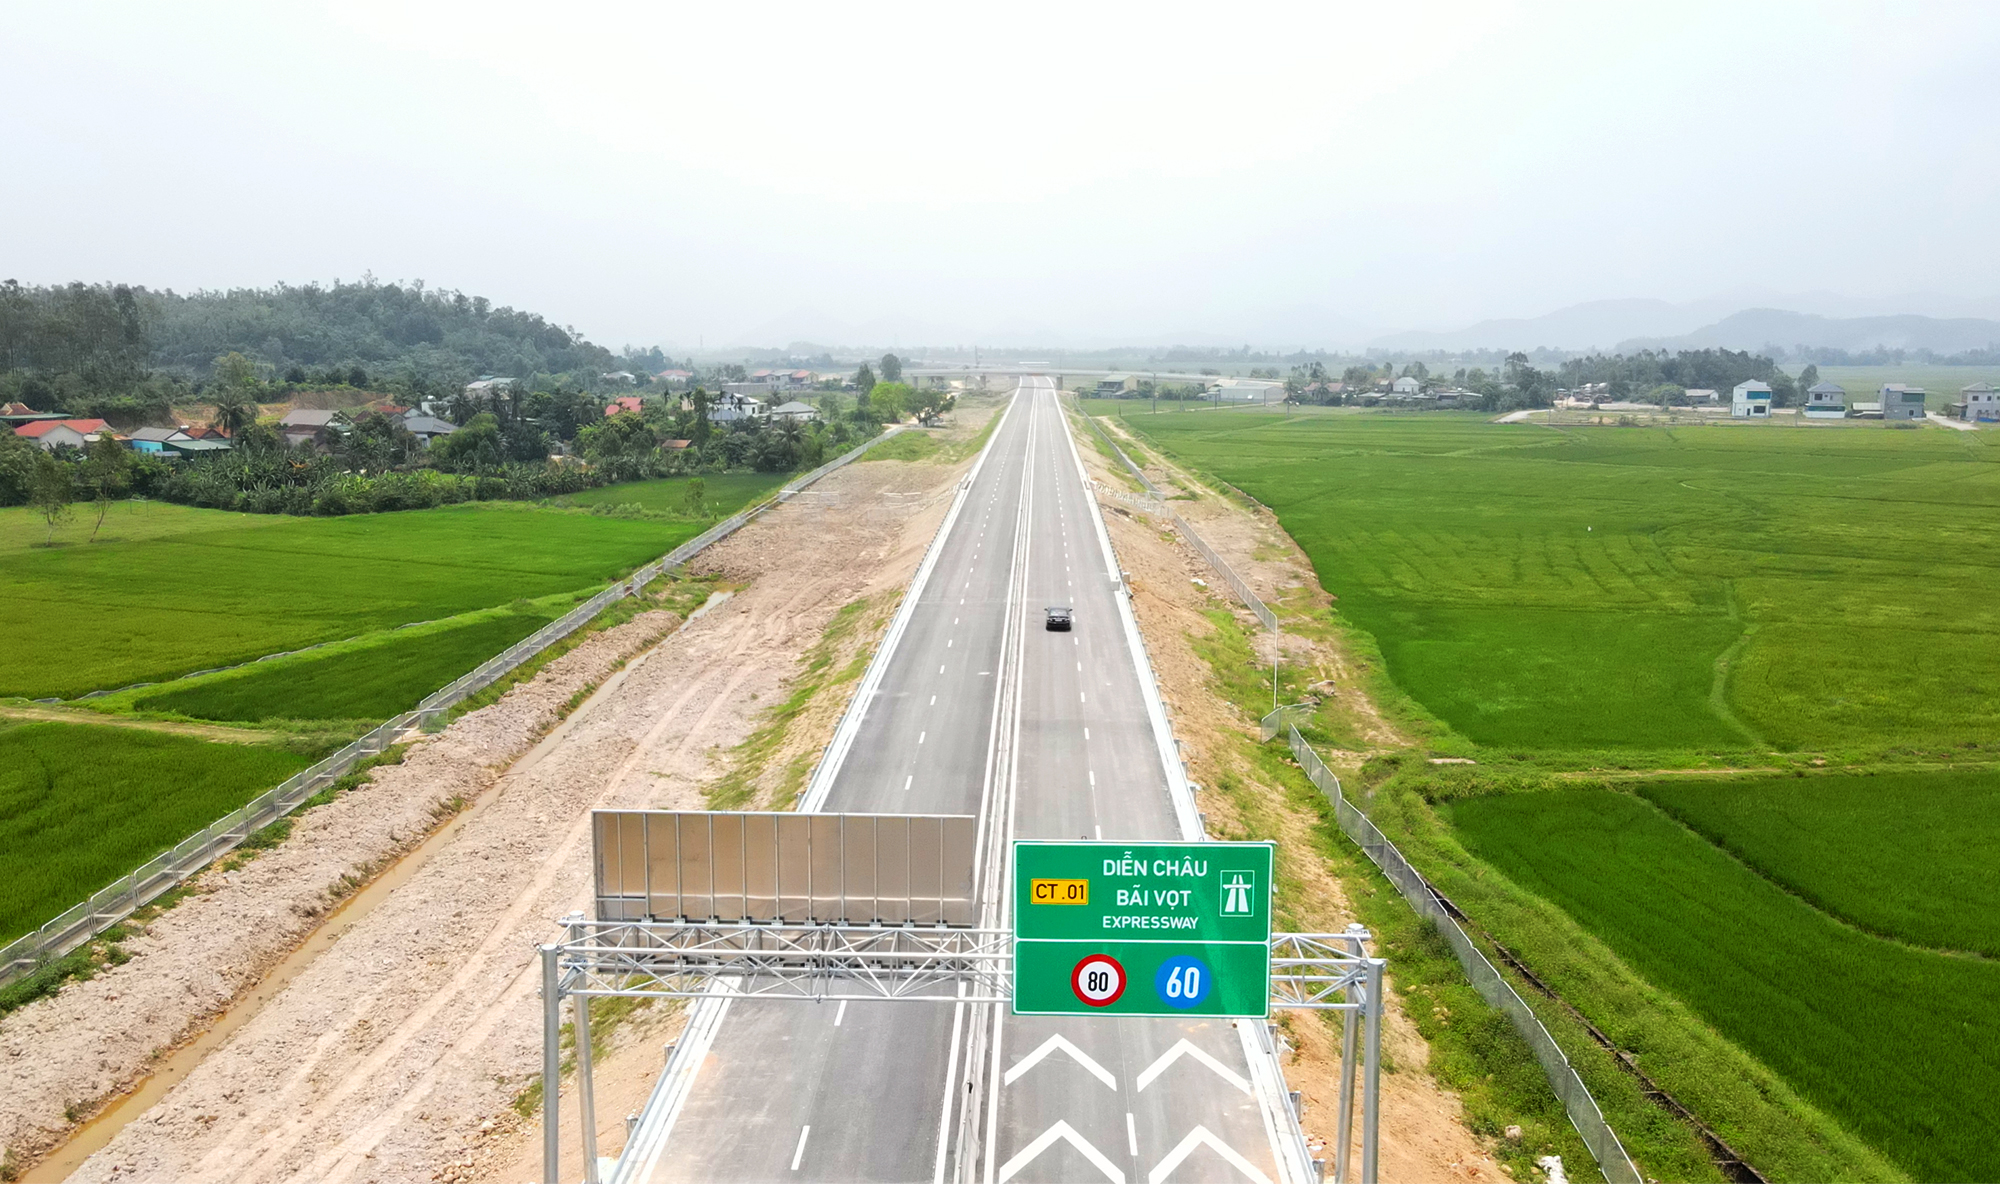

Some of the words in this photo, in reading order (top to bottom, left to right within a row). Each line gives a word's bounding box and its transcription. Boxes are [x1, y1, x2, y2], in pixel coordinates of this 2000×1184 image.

[1103, 851, 1147, 877] DIỄN
[1153, 855, 1208, 877] CHÂU
[1117, 884, 1149, 906] BÃI
[1153, 889, 1192, 910] VỌT
[1102, 915, 1199, 929] EXPRESSWAY
[1087, 971, 1109, 992] 80
[1166, 966, 1200, 999] 60
